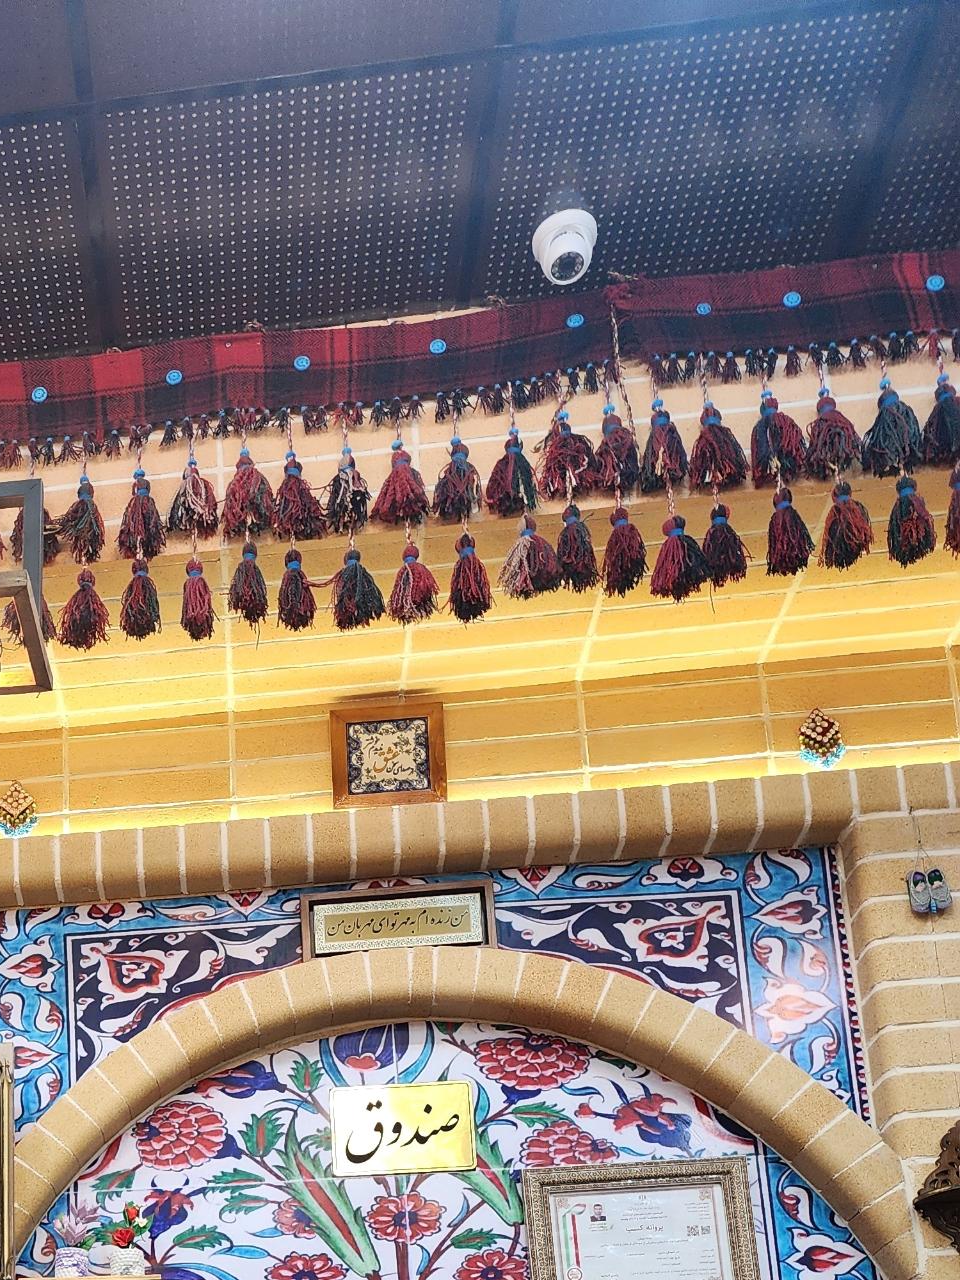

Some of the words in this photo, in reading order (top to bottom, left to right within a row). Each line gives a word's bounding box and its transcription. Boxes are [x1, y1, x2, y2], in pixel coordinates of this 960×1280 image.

[372, 916, 389, 933] ای
[395, 916, 410, 932] مهر
[430, 909, 451, 924] زنده
[450, 910, 468, 927] من
[327, 919, 344, 936] من
[343, 917, 375, 937] مهربان
[409, 918, 416, 933] به
[345, 1100, 460, 1164] صندوق
